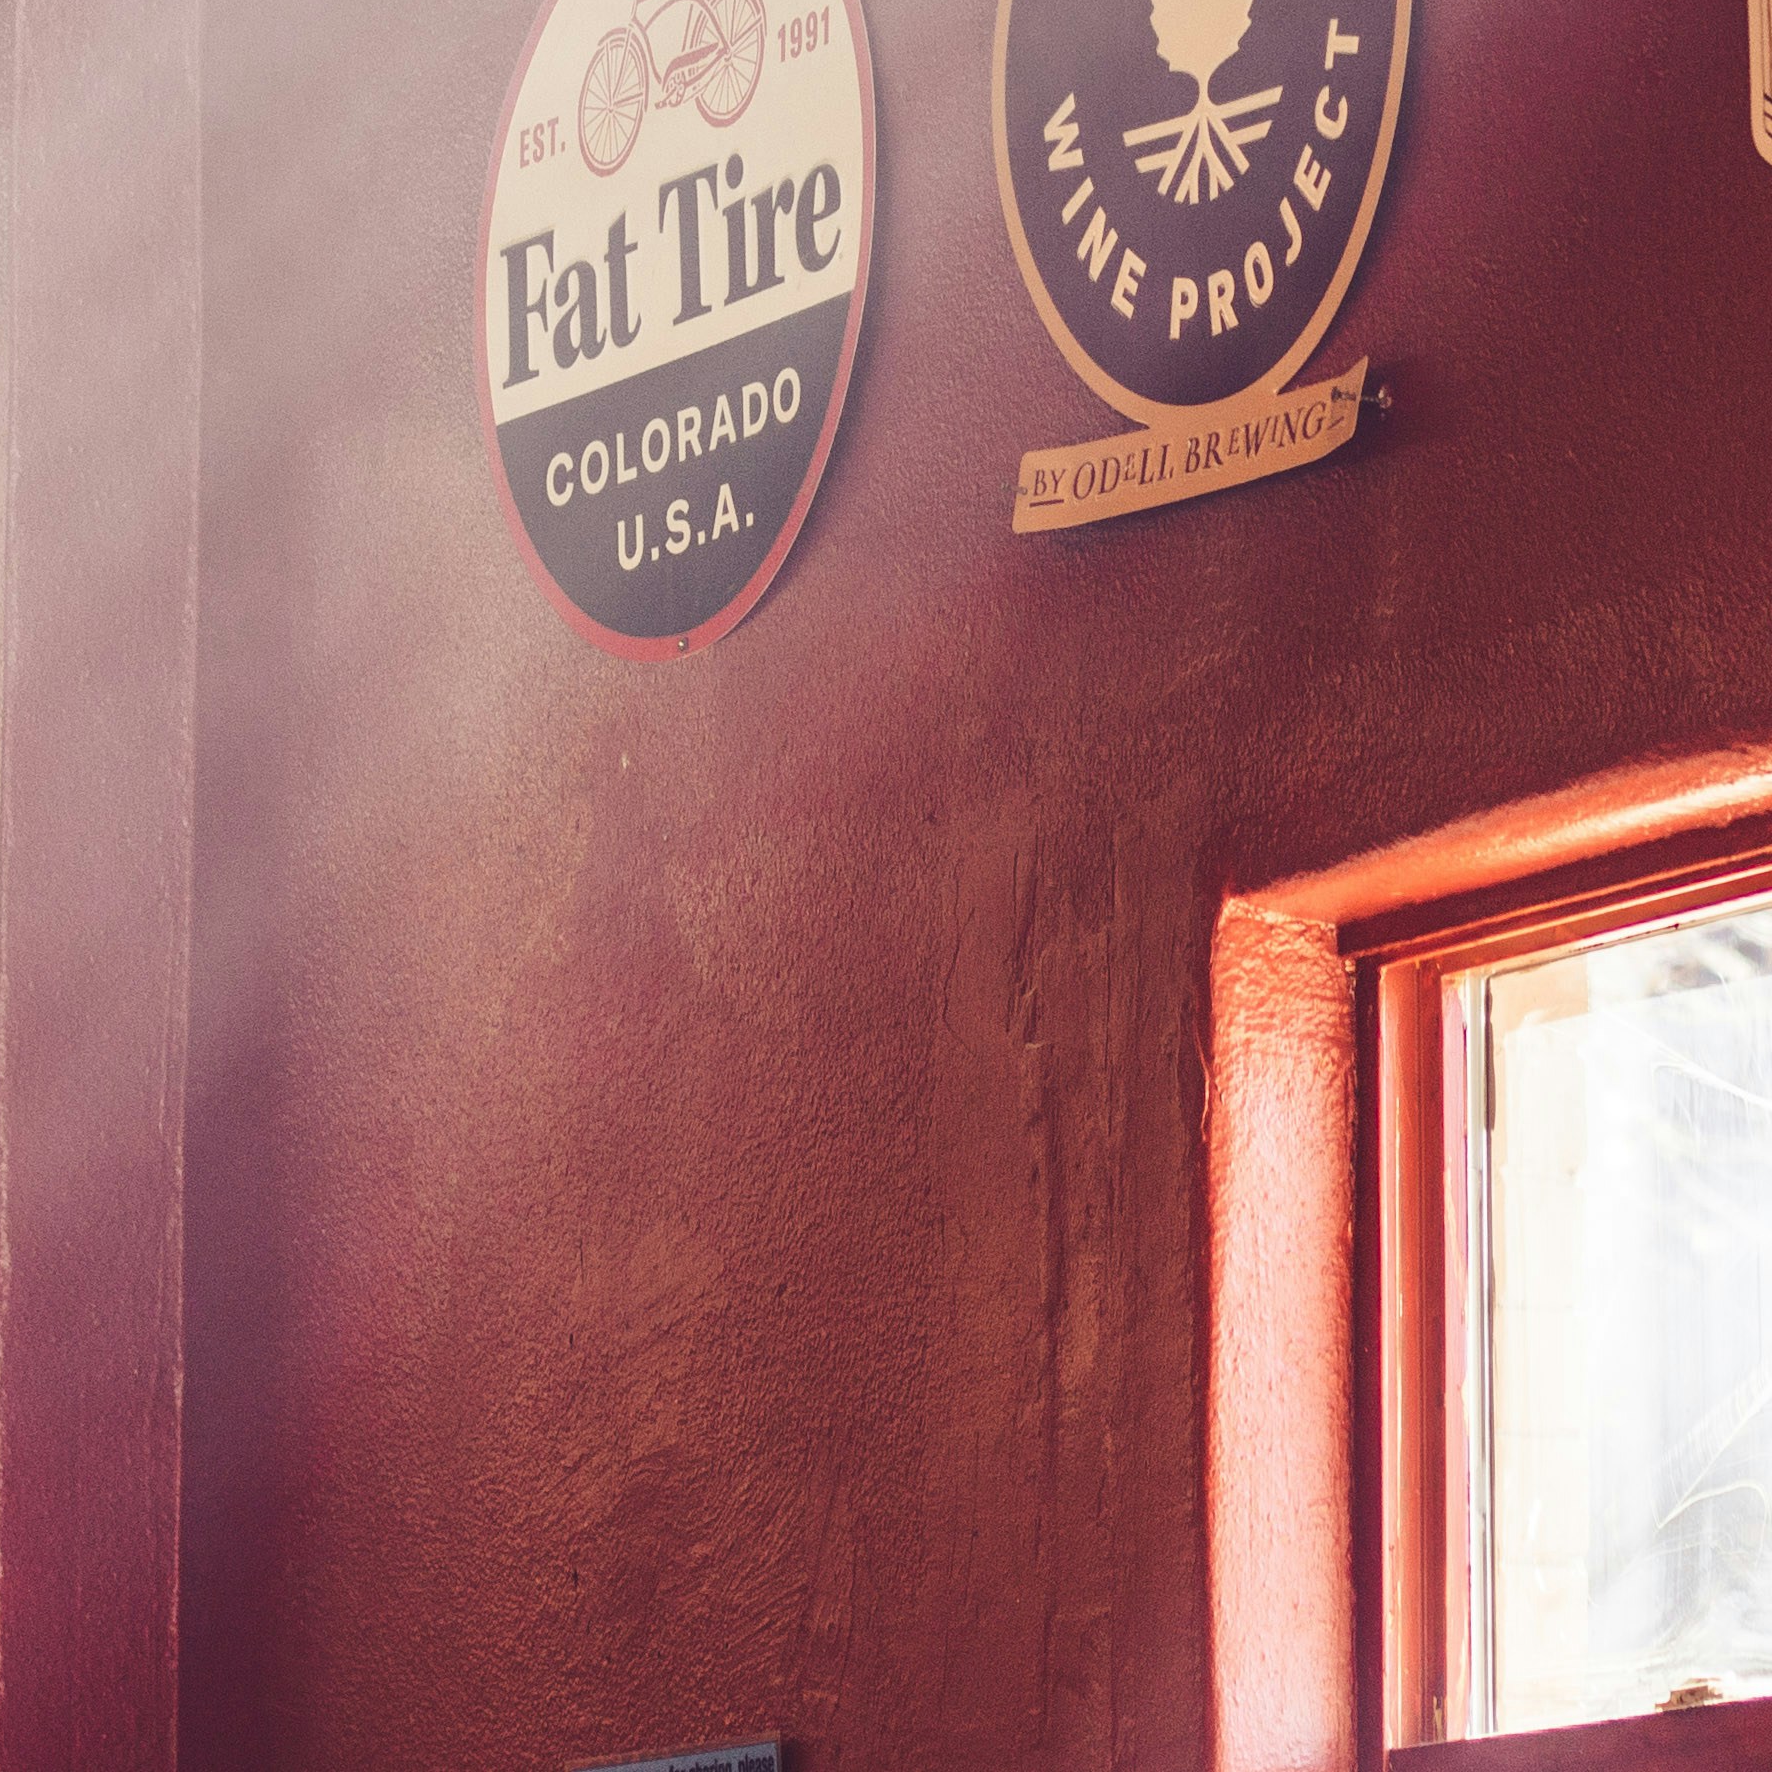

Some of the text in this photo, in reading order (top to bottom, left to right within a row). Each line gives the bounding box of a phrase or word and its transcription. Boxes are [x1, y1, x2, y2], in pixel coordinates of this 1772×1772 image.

[519, 5, 830, 168] EST. 1991
[1043, 16, 1361, 341] WINE PROJECT
[499, 152, 842, 391] Fat Tire
[545, 366, 803, 508] COLORADO
[1032, 467, 1068, 498] BY
[1184, 400, 1327, 475] BREWING
[615, 481, 757, 572] U.S.A.
